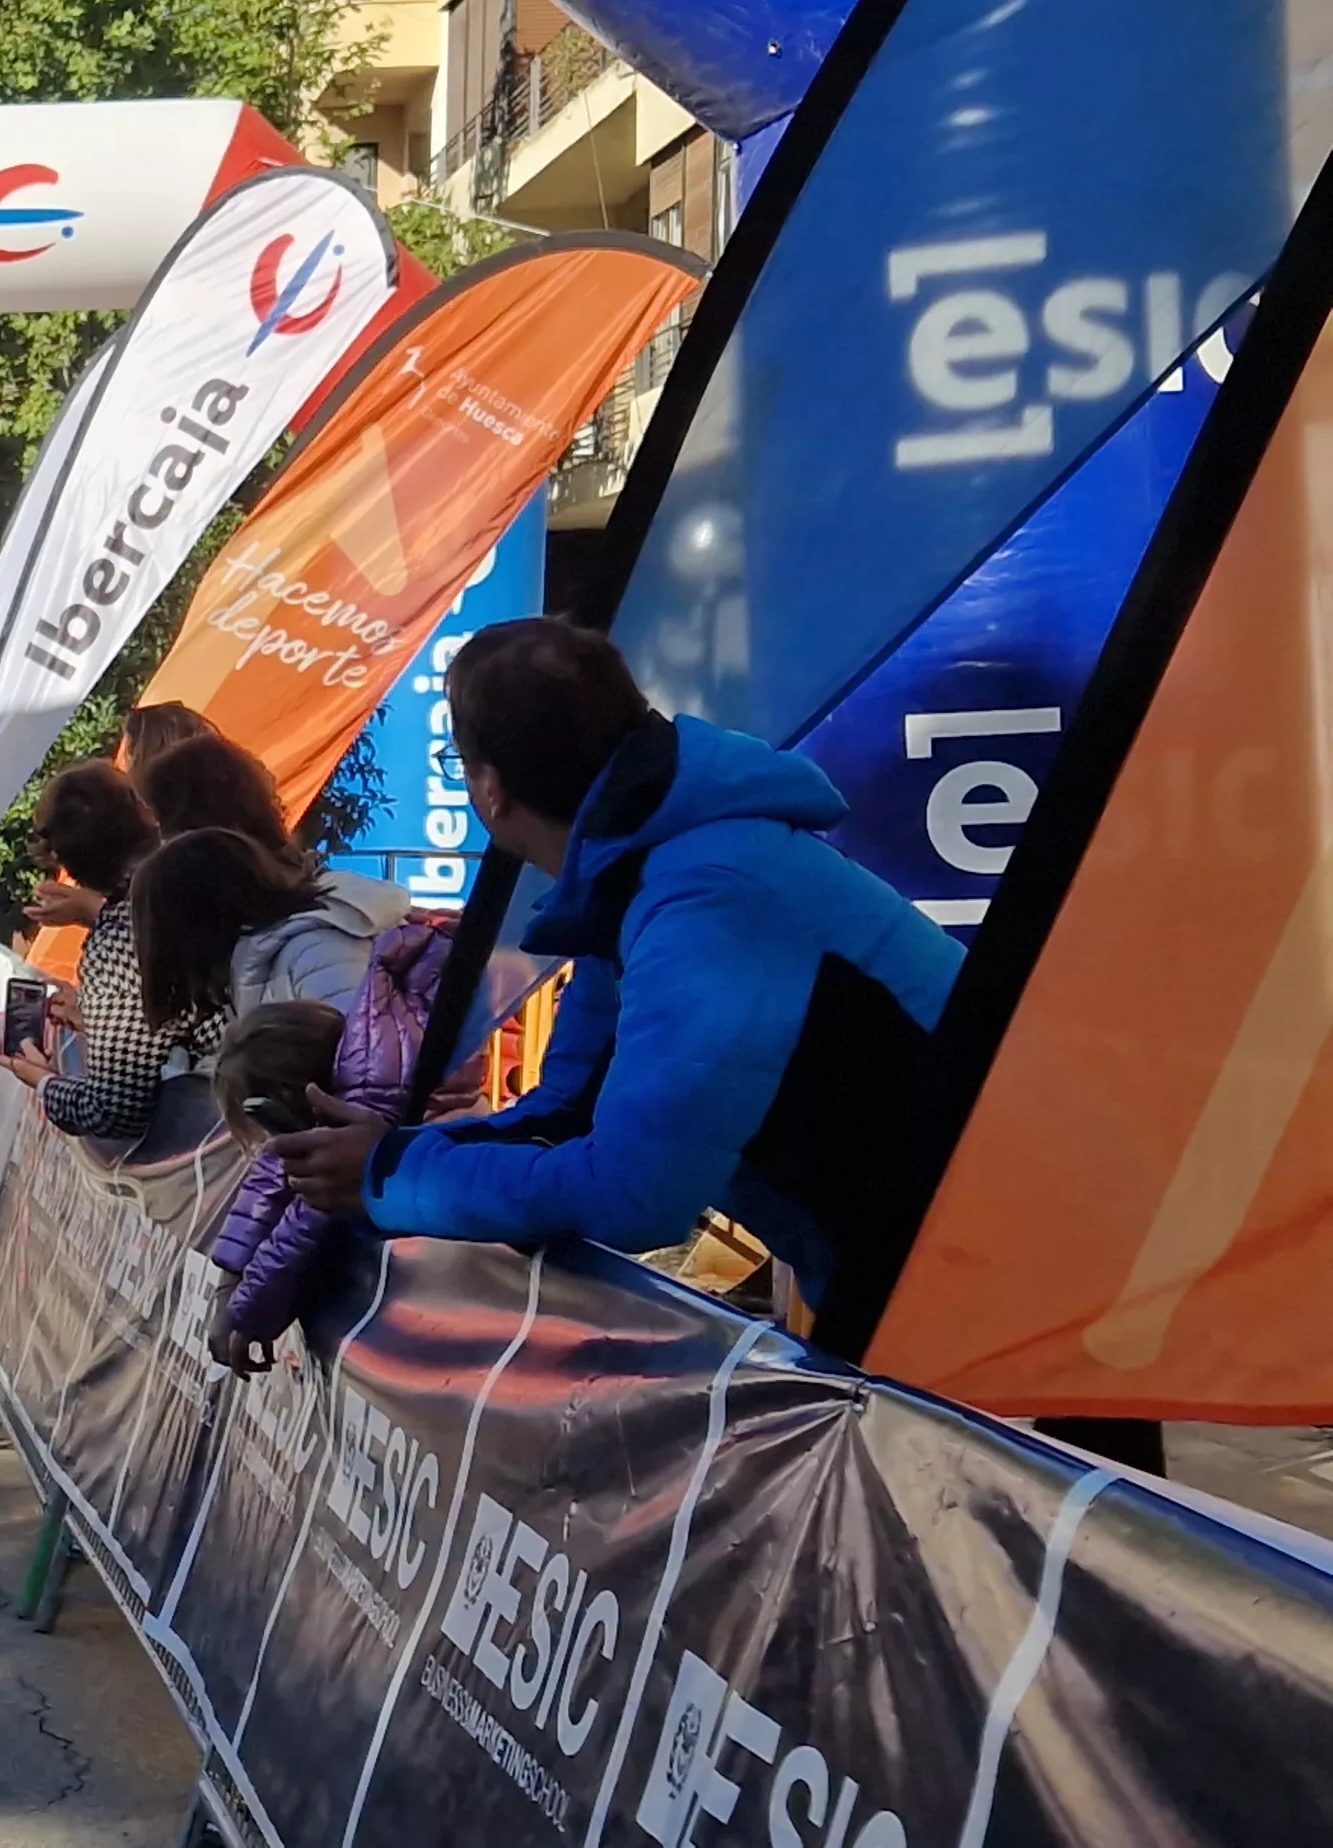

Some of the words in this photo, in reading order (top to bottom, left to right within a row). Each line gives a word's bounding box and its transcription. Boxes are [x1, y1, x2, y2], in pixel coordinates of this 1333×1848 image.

[436, 382, 459, 405] de
[459, 395, 525, 446] Huesca
[450, 367, 560, 442] Ayuntamiento
[24, 377, 250, 682] Ibercaja
[207, 590, 368, 689] deporte
[220, 540, 405, 656] Hacemos
[347, 1404, 439, 1590] ESIC
[473, 1519, 620, 1757] ESIC
